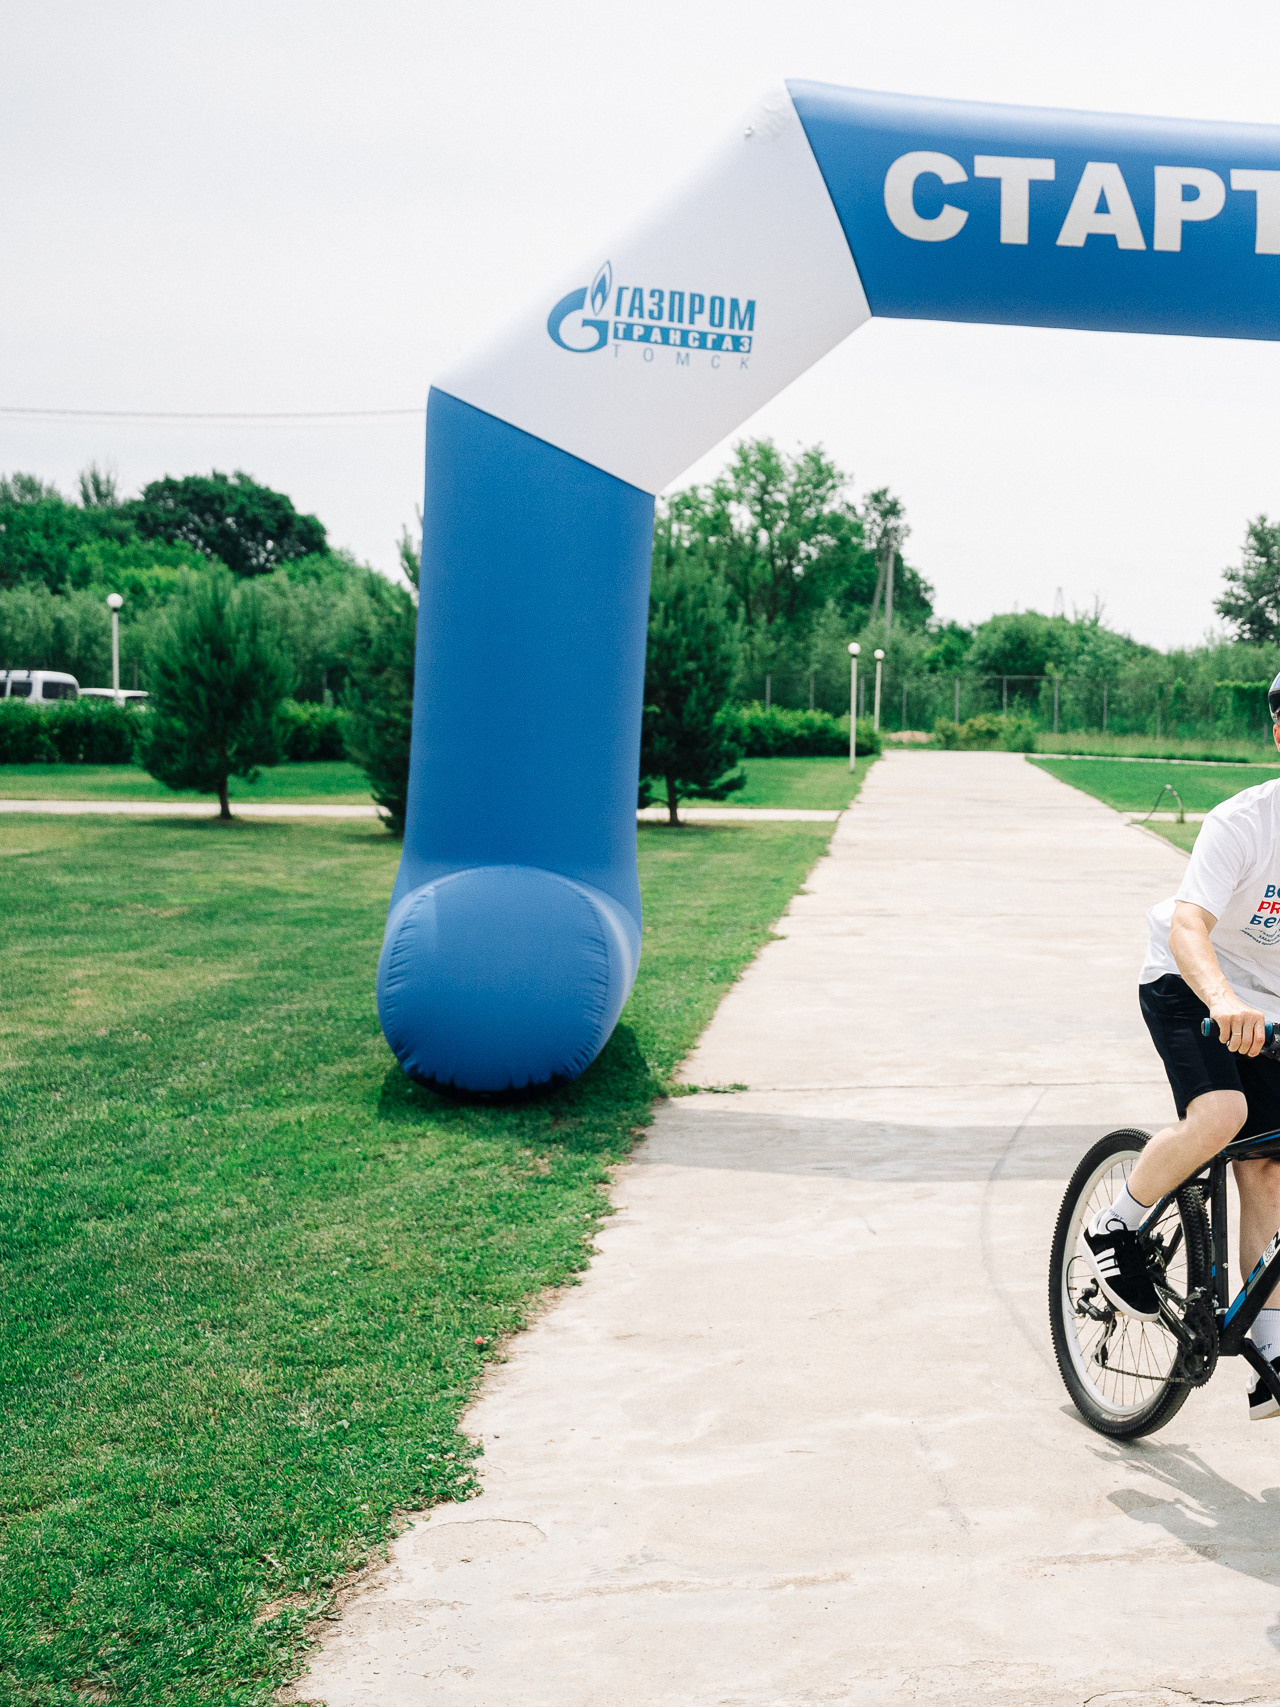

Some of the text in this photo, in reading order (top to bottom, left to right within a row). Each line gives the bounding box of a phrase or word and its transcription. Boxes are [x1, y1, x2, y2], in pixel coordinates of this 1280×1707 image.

[614, 286, 756, 332] ГАЗПРОМ
[614, 322, 752, 353] ТРАНСГАЗ
[612, 343, 750, 370] ТОМСК
